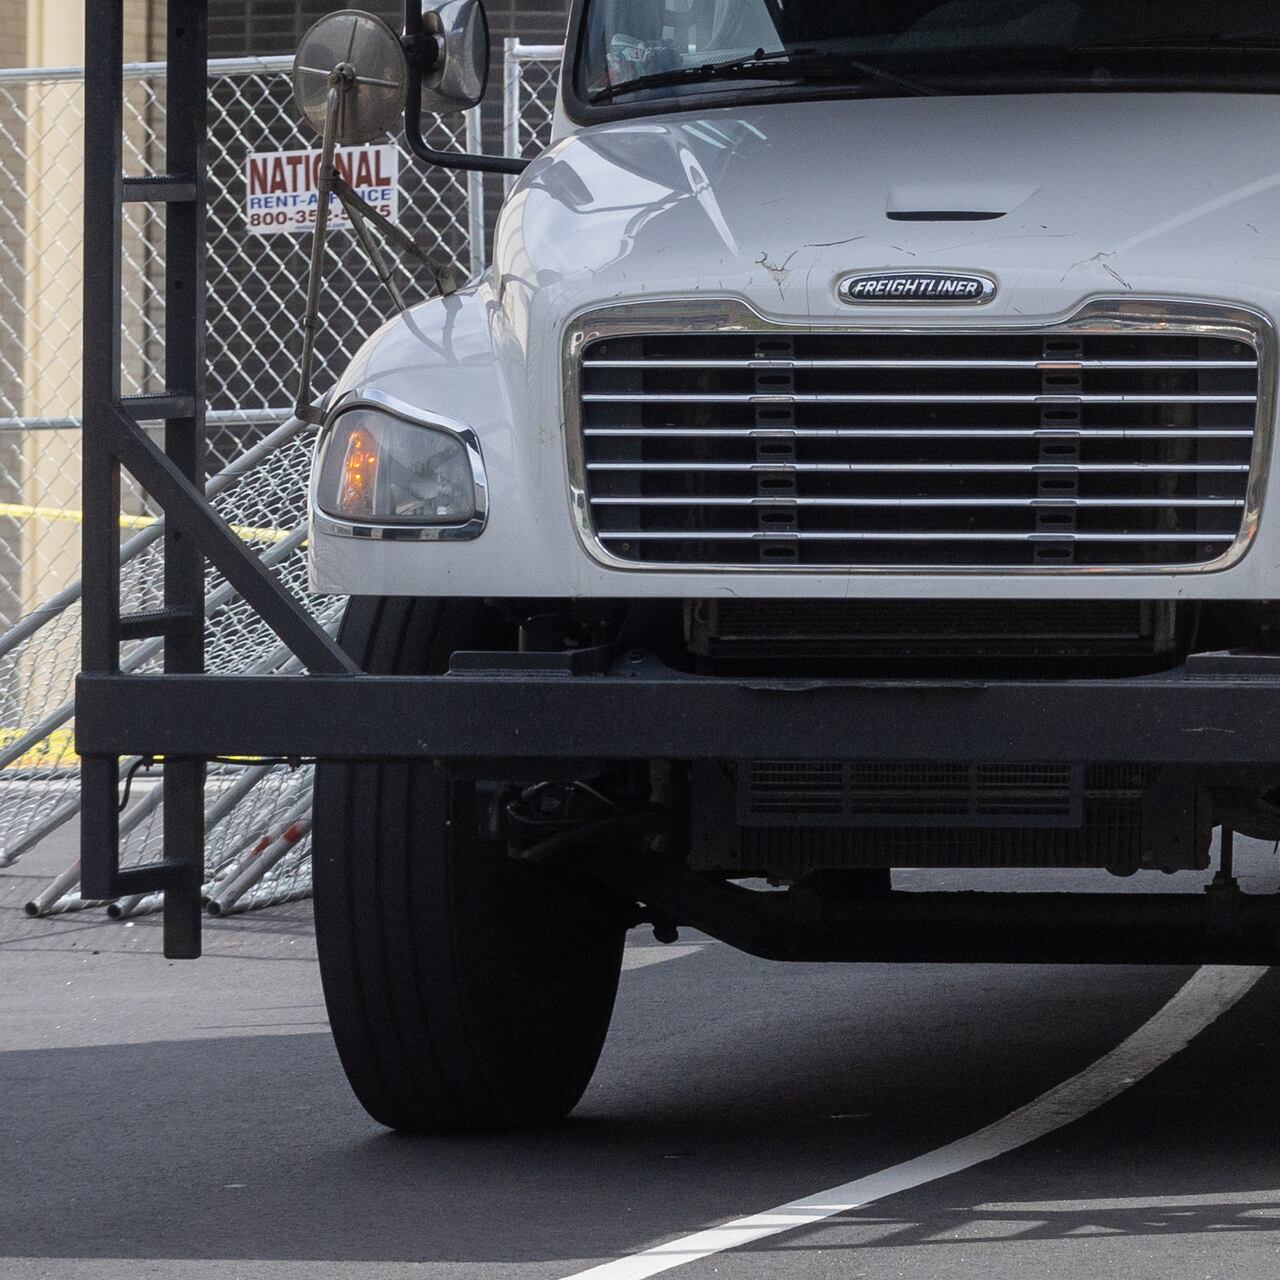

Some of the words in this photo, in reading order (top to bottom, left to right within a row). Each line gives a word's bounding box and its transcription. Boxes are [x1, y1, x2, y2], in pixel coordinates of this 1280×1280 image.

[250, 189, 393, 209] RENT-AFCE
[250, 204, 391, 227] 800-352-55
[852, 278, 978, 294] FREIGHTLINER
